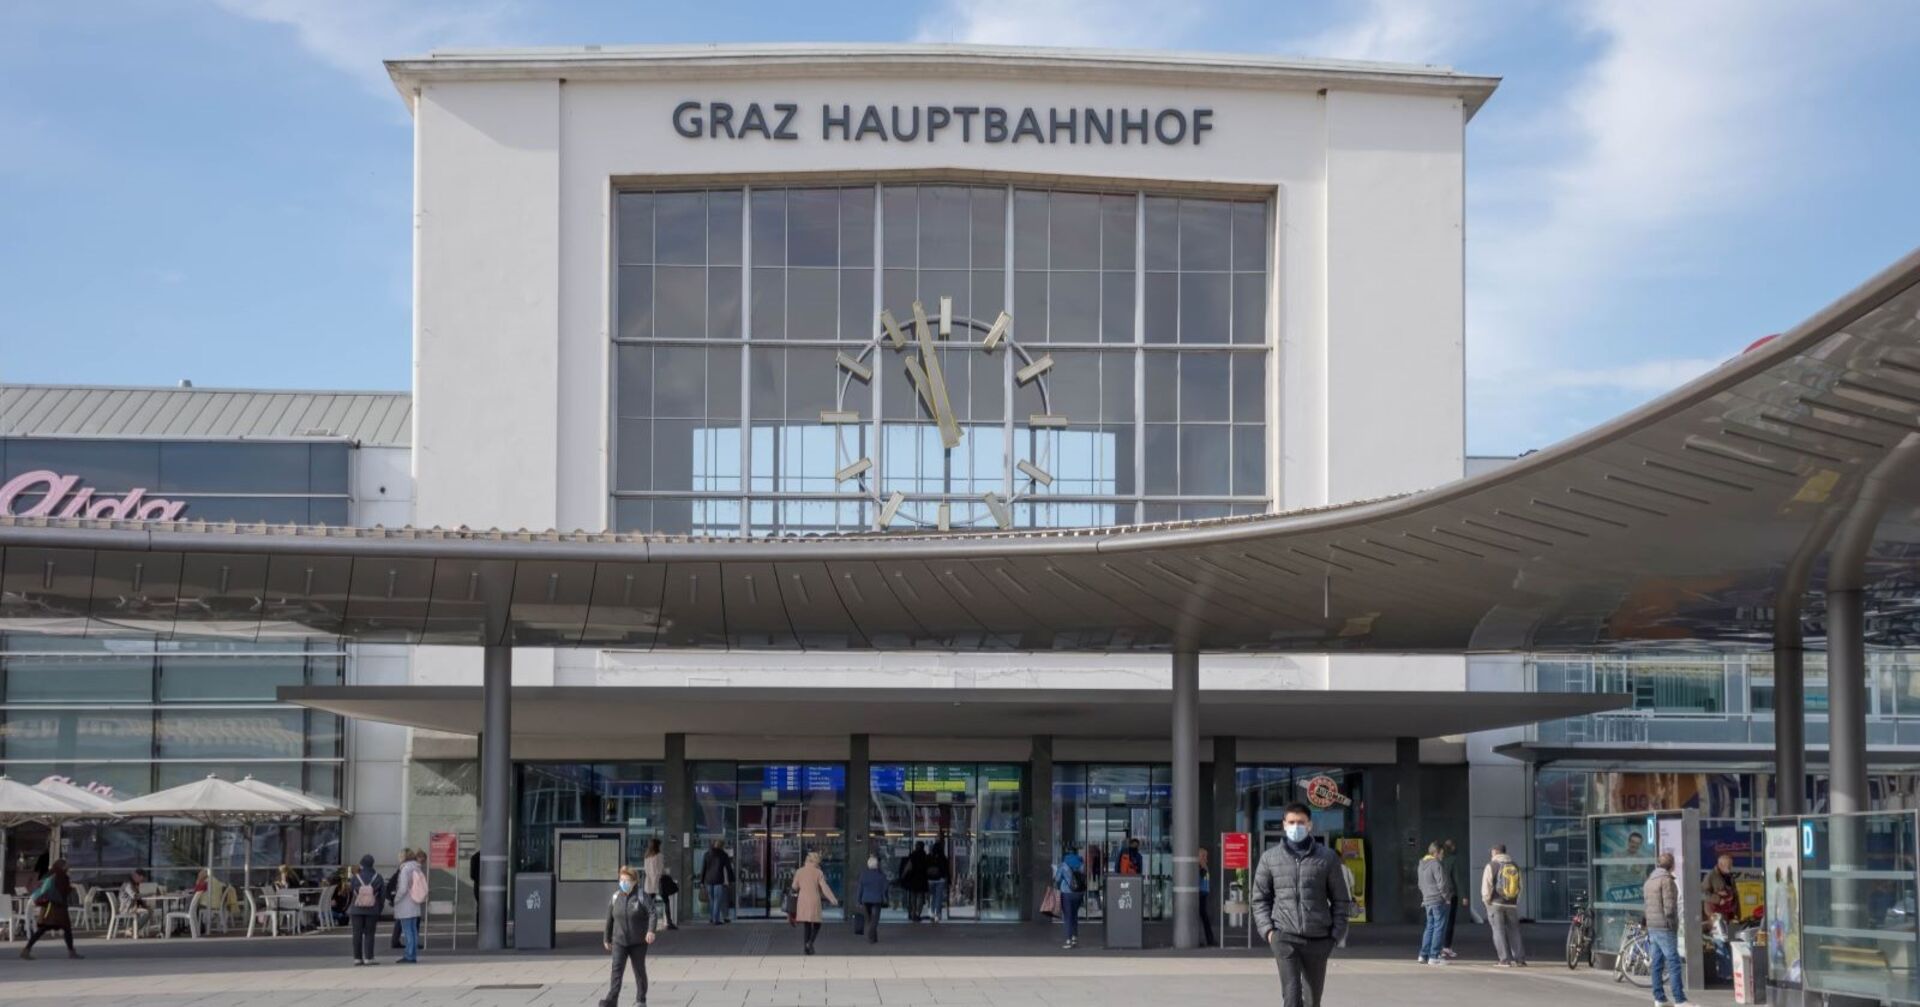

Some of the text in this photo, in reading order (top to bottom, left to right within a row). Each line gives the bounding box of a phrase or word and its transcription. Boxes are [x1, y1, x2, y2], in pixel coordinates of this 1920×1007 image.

[672, 101, 1213, 145] GRAZ HAUPTBAHNHOF
[1647, 819, 1655, 845] D
[1803, 825, 1814, 856] D
